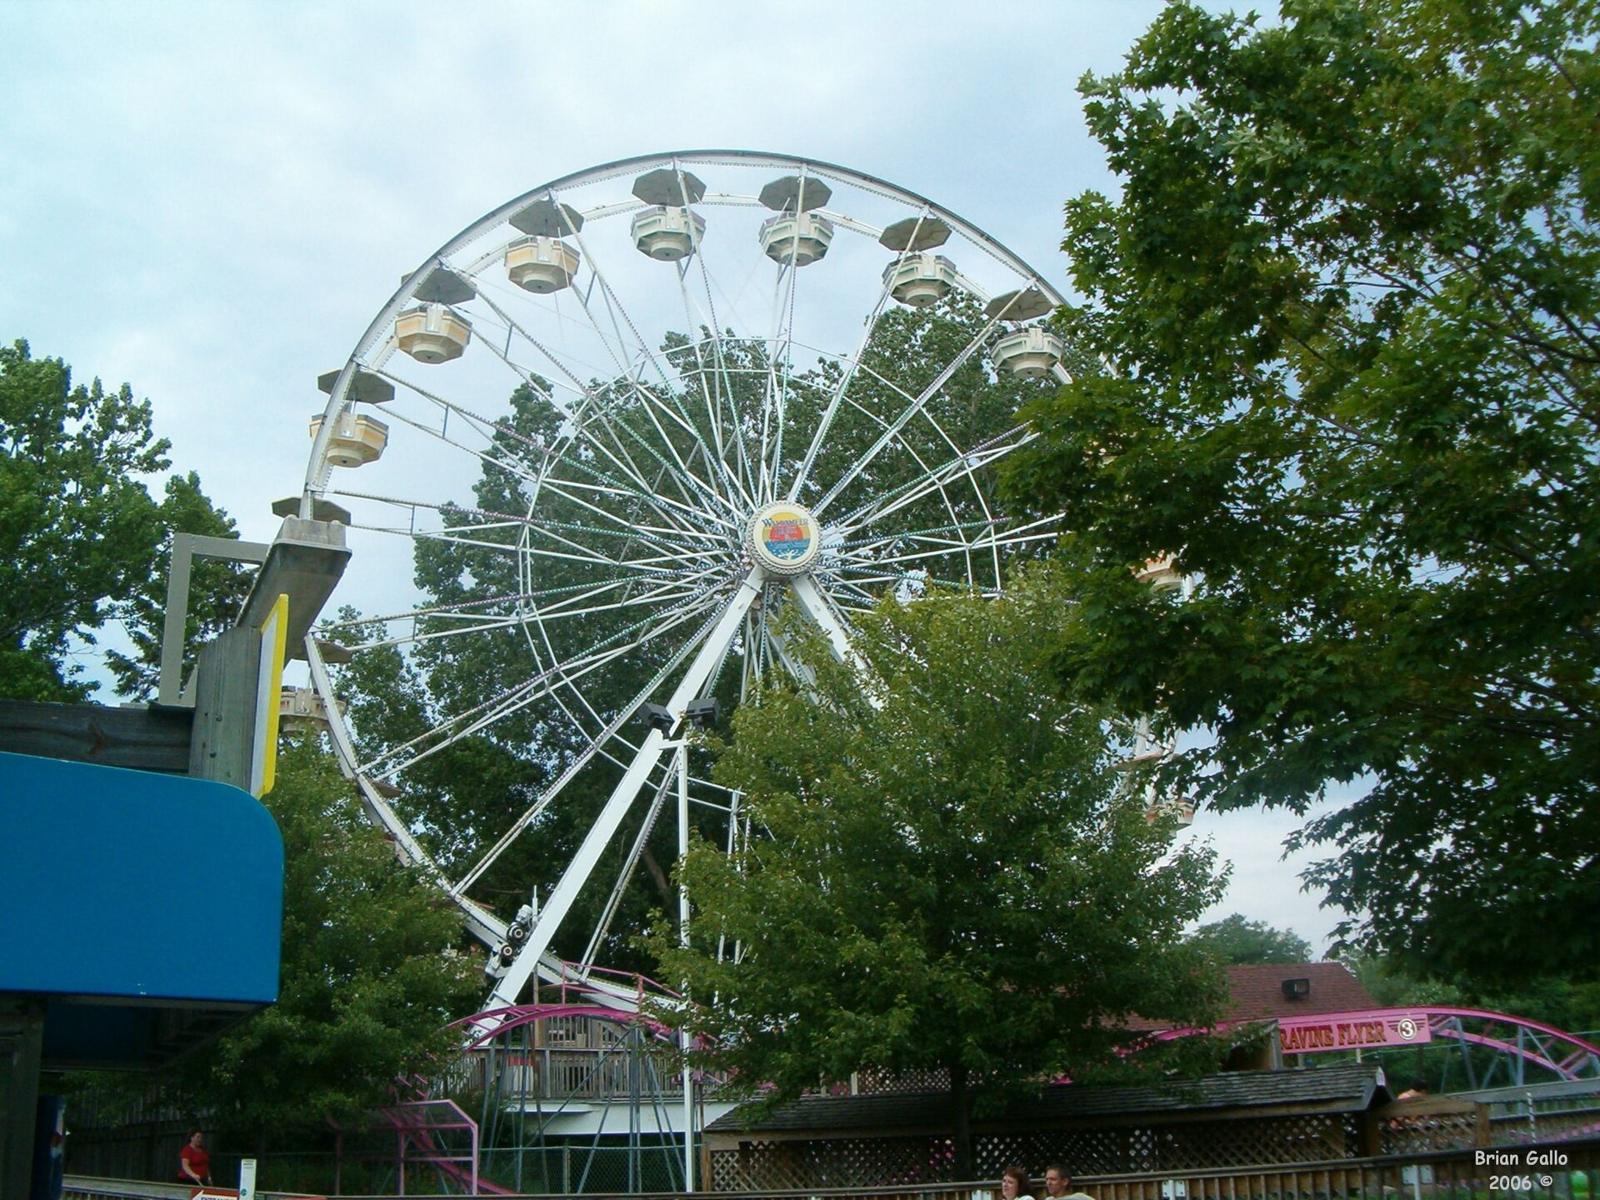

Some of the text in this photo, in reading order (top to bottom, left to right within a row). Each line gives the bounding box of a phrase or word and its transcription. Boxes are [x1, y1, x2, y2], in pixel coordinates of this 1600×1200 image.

[1279, 1020, 1415, 1050] RAVINE FLYER 3
